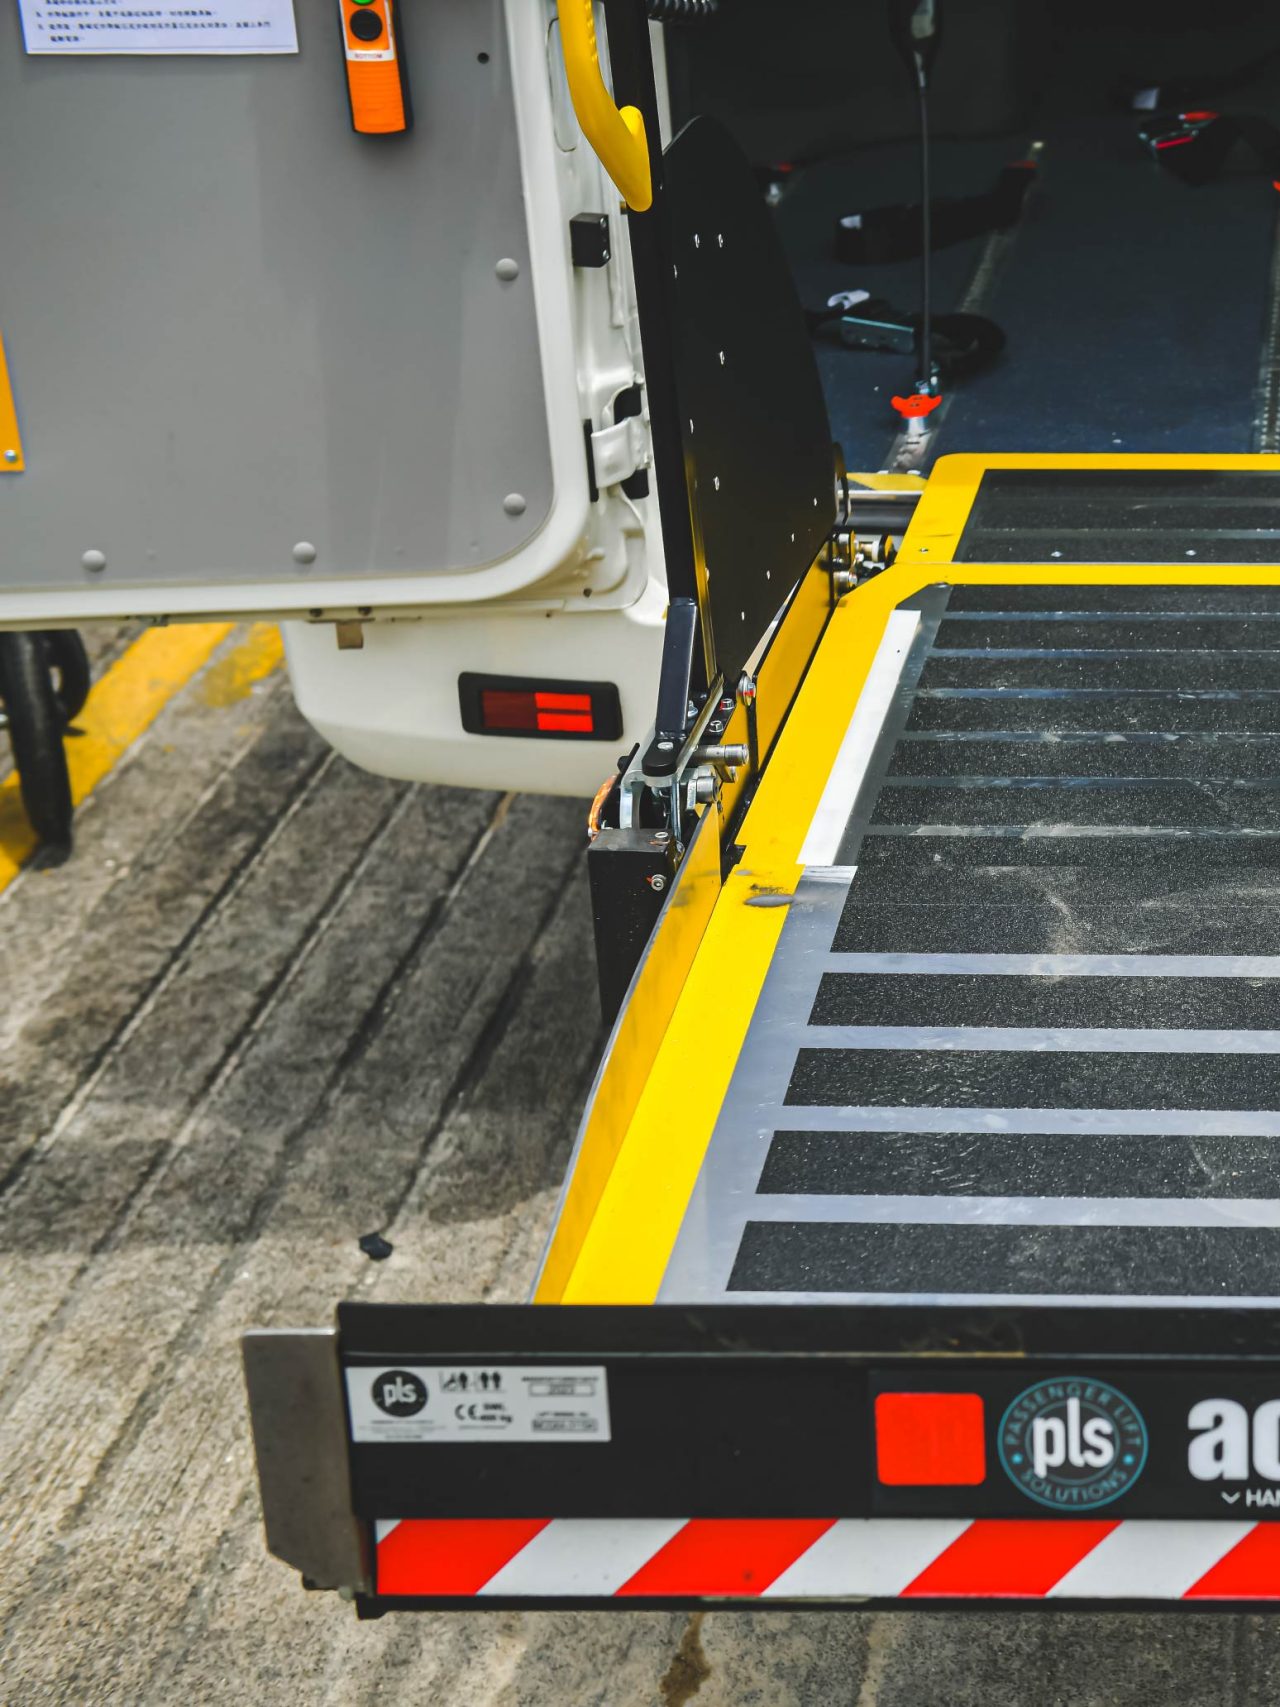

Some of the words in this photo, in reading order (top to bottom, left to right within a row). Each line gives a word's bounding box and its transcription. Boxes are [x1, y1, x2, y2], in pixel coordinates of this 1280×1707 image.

[382, 1376, 418, 1407] pls
[1005, 1382, 1112, 1446] PASSENGER
[1113, 1404, 1142, 1446] LIFT
[1032, 1396, 1115, 1479] pls
[1020, 1468, 1128, 1503] SOLUTIONS
